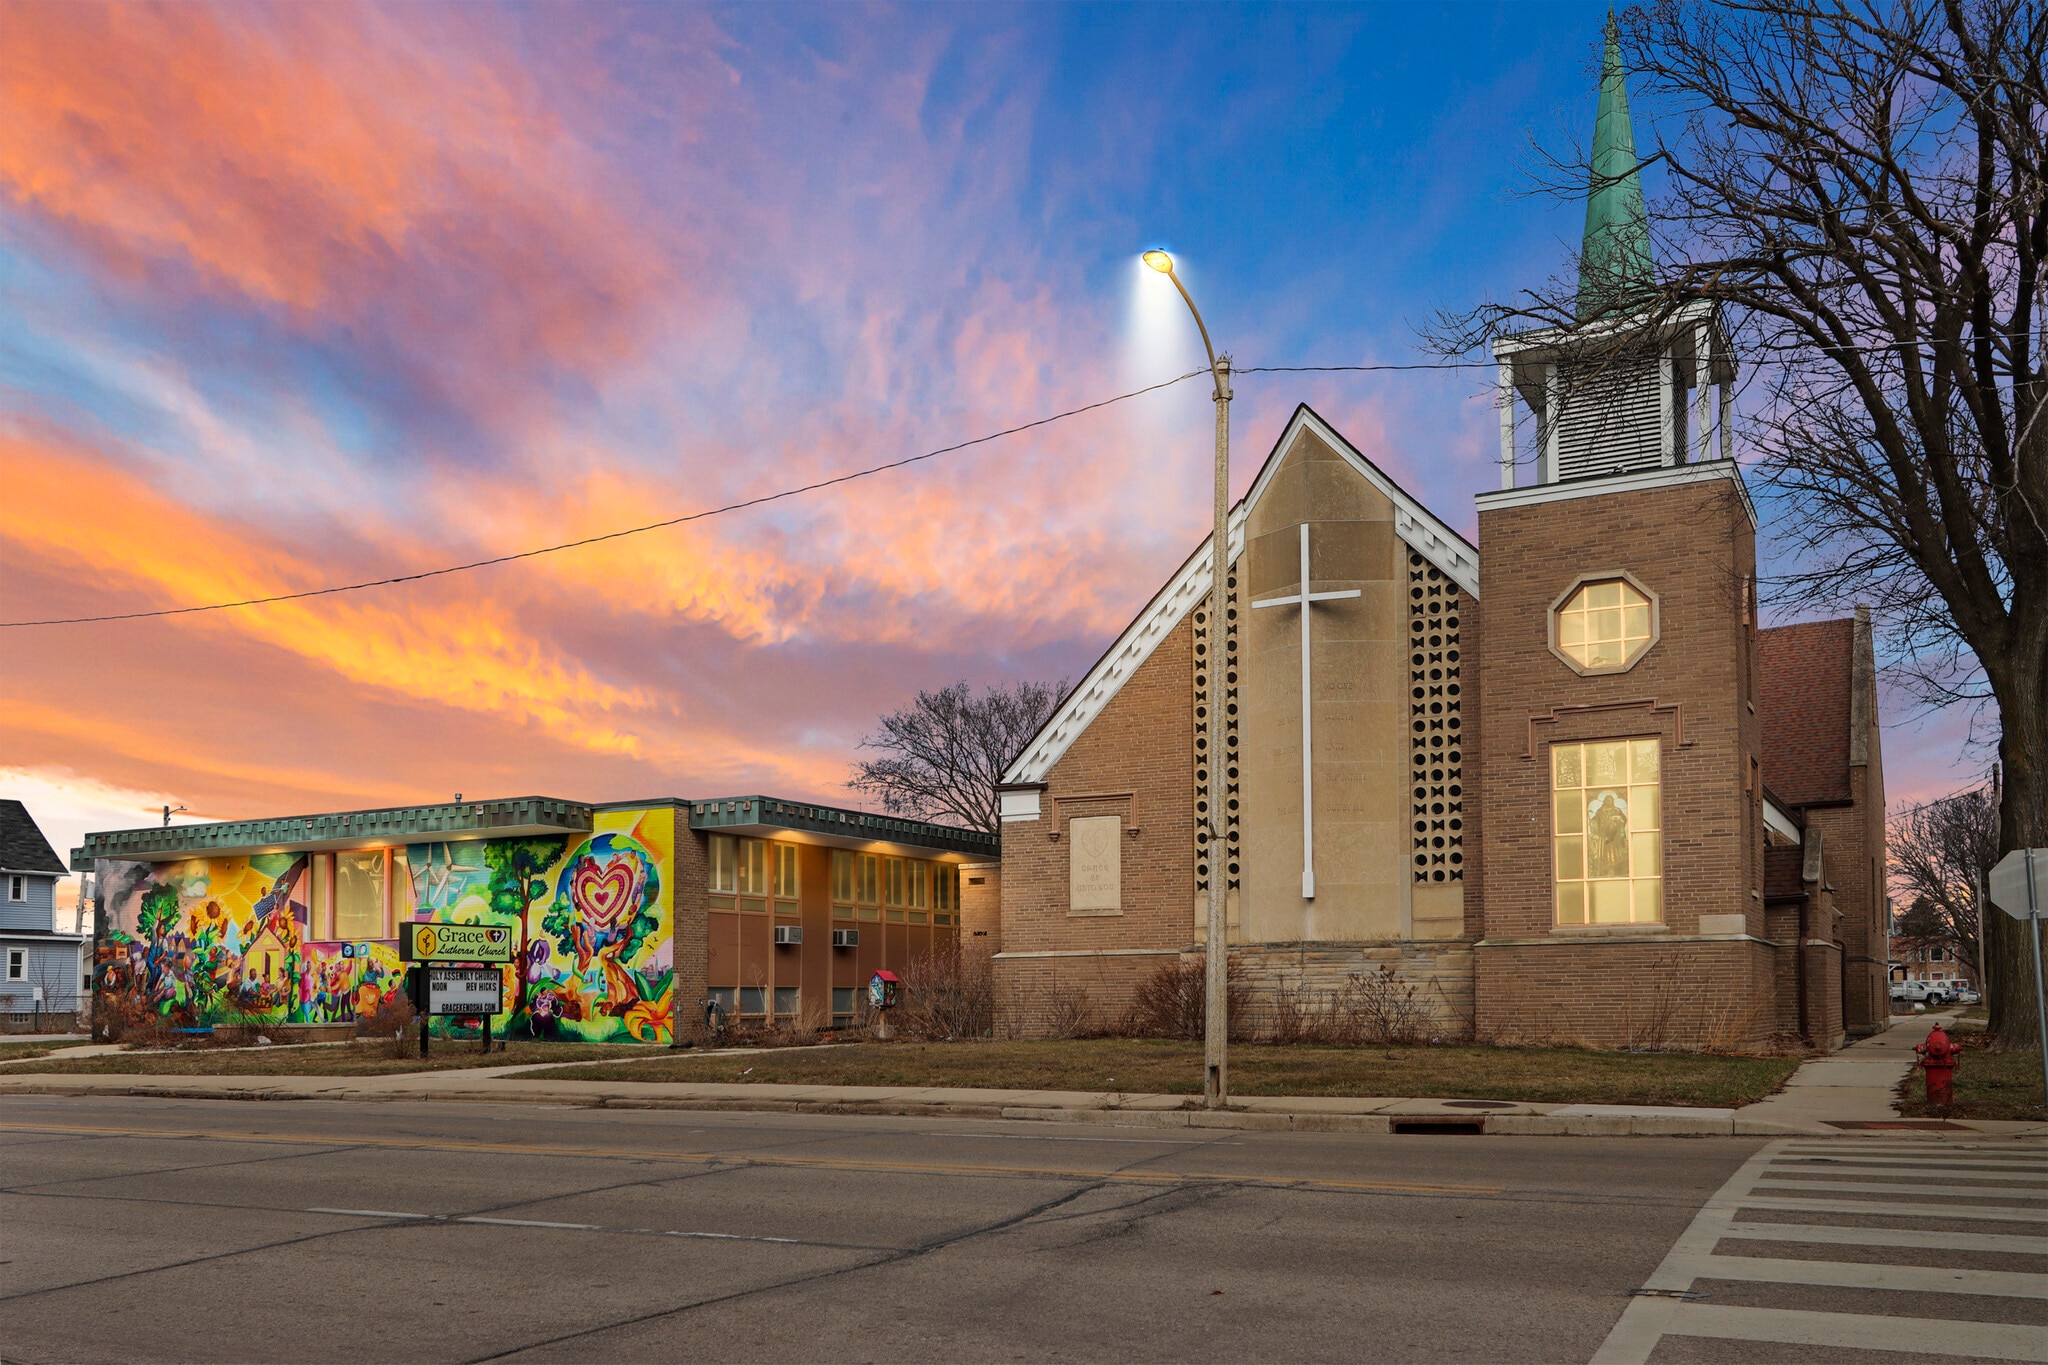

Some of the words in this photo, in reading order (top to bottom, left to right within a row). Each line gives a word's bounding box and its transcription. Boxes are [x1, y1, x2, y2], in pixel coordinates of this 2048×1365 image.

[438, 927, 484, 943] Grace
[437, 943, 475, 955] Lutheran
[477, 945, 506, 957] Church
[444, 971, 474, 981] ASSEMBLY
[475, 971, 497, 981] CHURCH
[432, 982, 447, 991] NOON
[466, 982, 477, 991] REV
[478, 982, 497, 991] HICKS
[442, 1003, 482, 1012] GRACEKENOSHA
[484, 1003, 496, 1012] COM
